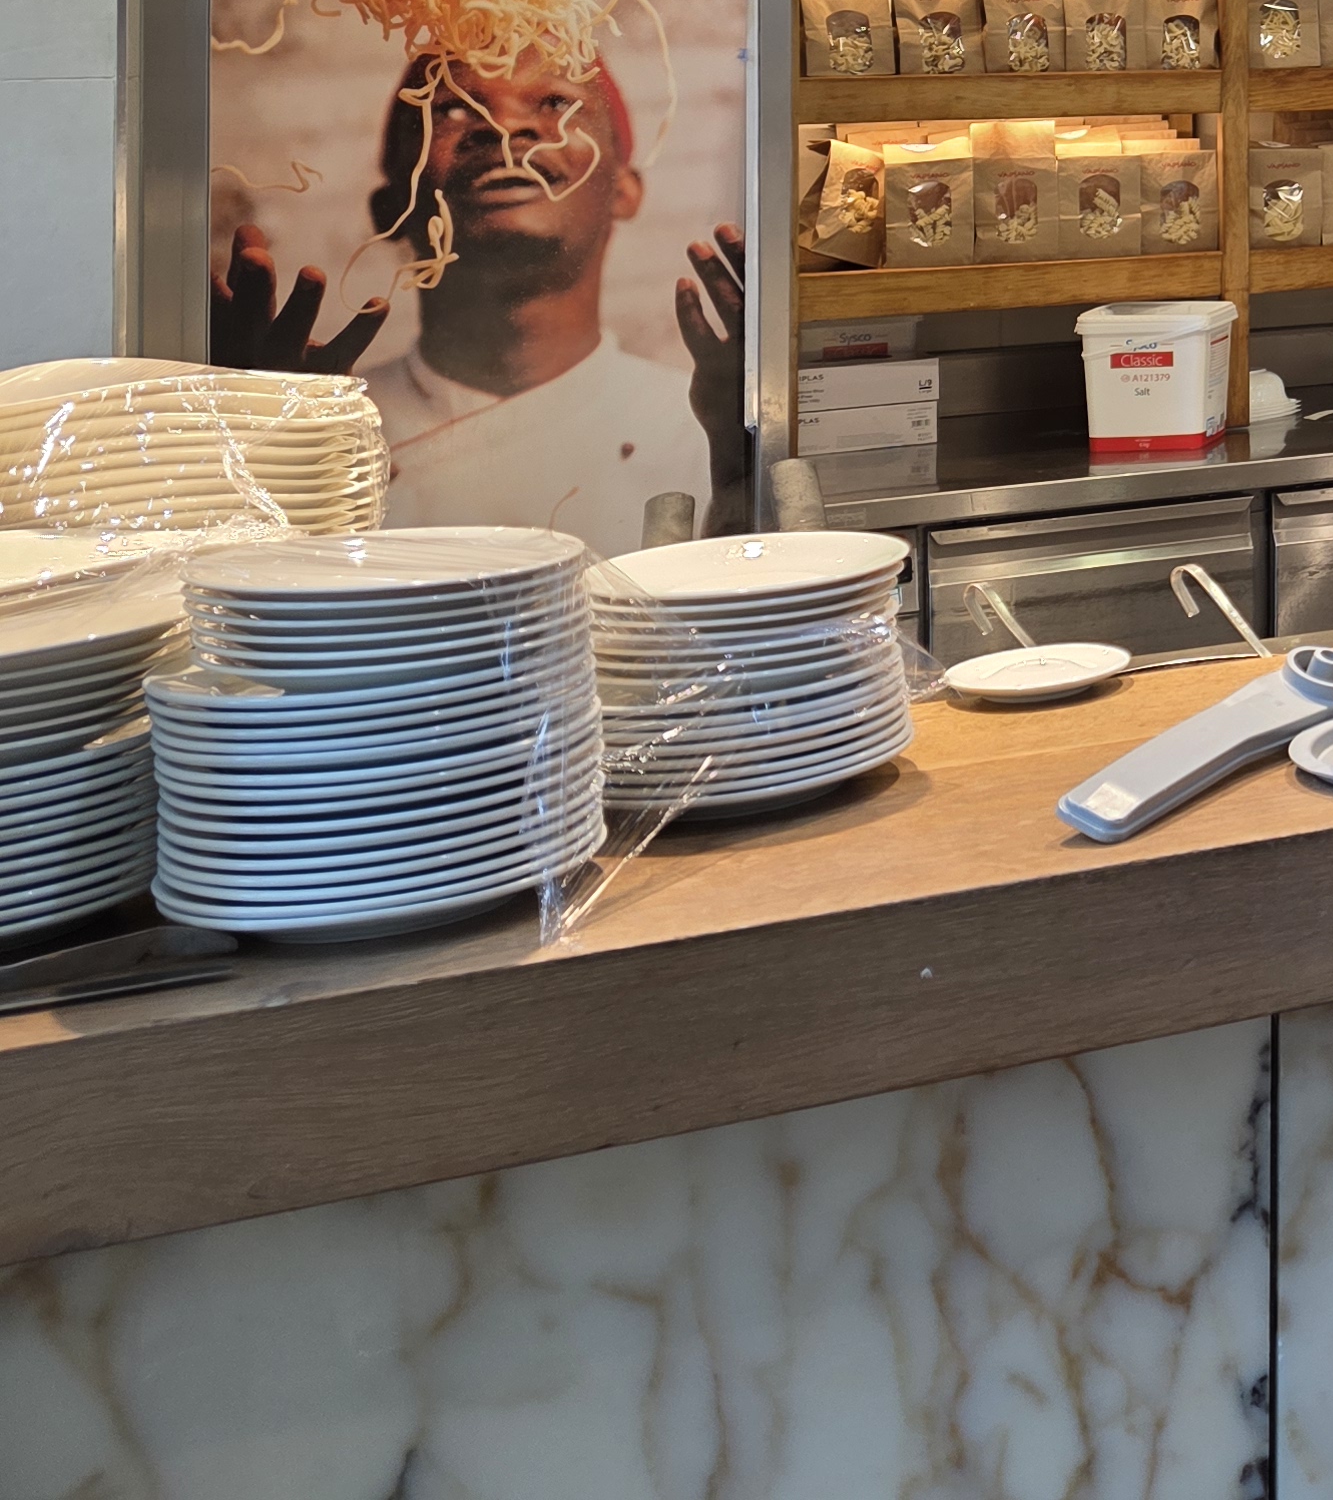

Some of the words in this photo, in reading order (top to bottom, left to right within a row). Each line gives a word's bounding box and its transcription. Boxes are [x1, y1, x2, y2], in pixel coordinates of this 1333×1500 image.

[839, 332, 872, 344] Sysco
[1120, 354, 1163, 368] Classic
[1132, 373, 1170, 382] A121379
[1134, 388, 1150, 396] Salt
